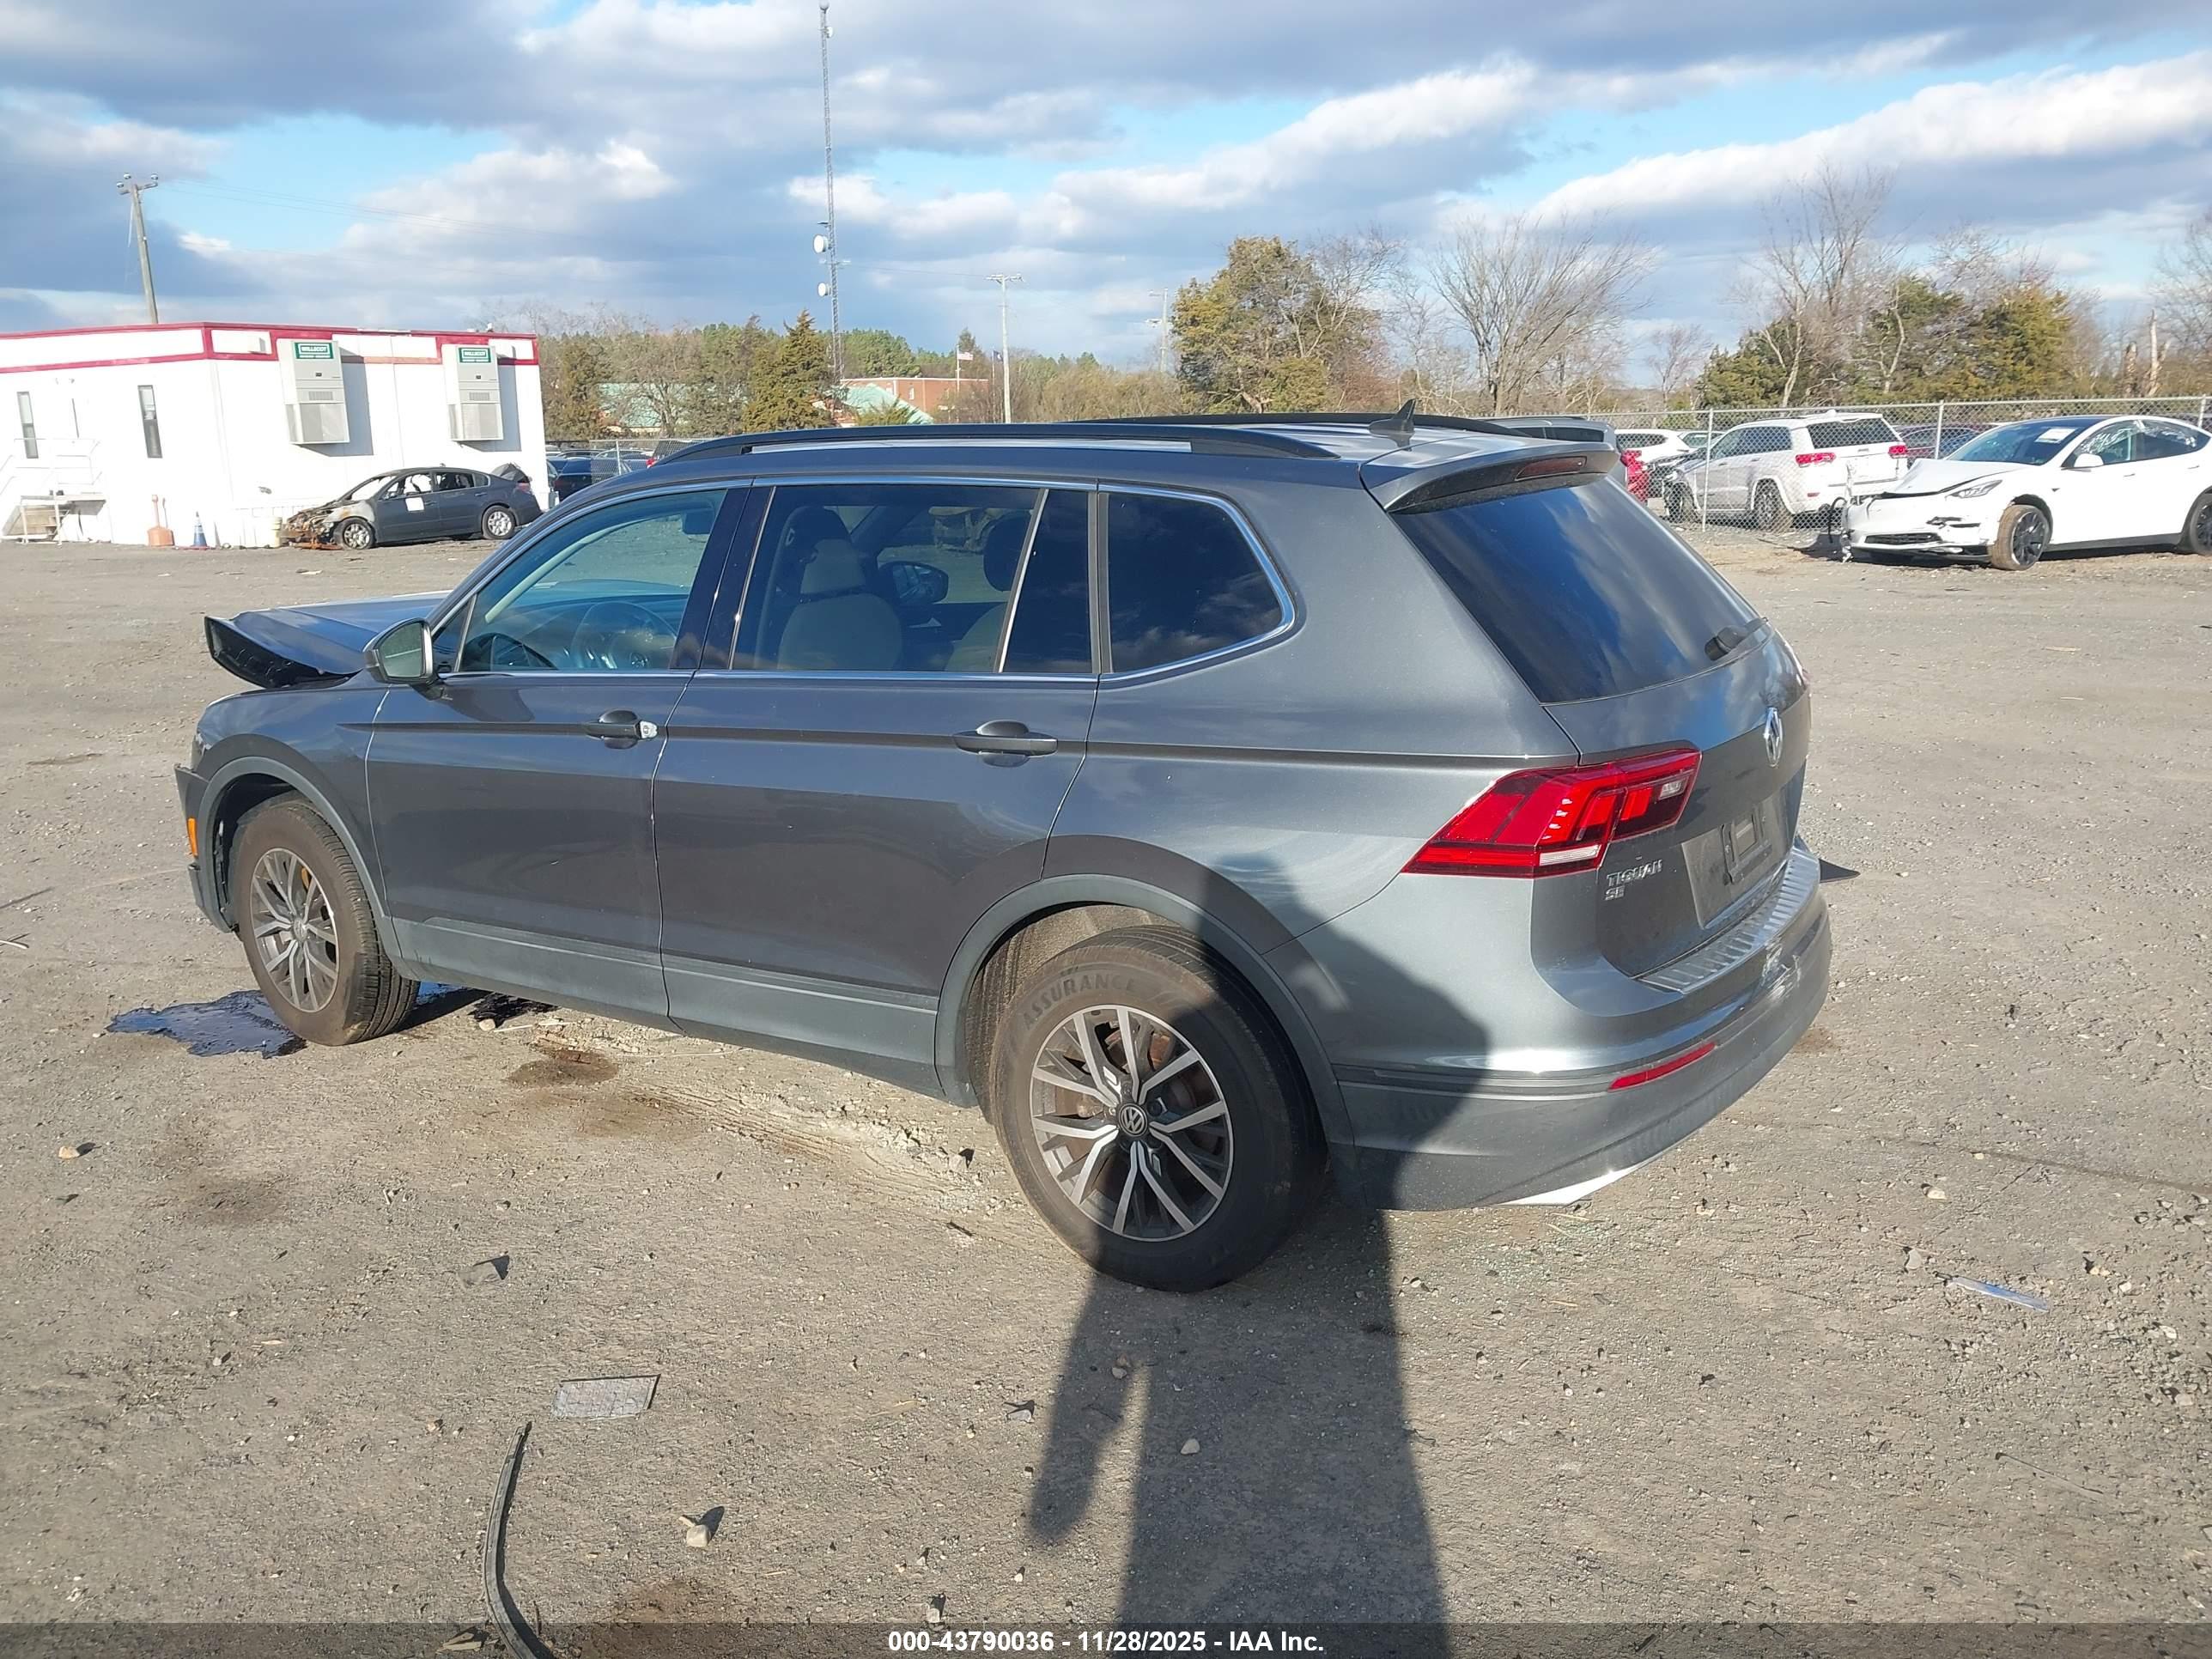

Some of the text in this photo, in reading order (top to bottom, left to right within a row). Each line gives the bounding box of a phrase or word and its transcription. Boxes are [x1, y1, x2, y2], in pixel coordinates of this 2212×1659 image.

[1607, 860, 1662, 887] TIGUAN
[1605, 885, 1625, 901] SE
[1022, 973, 1135, 1027] ASSURANCE
